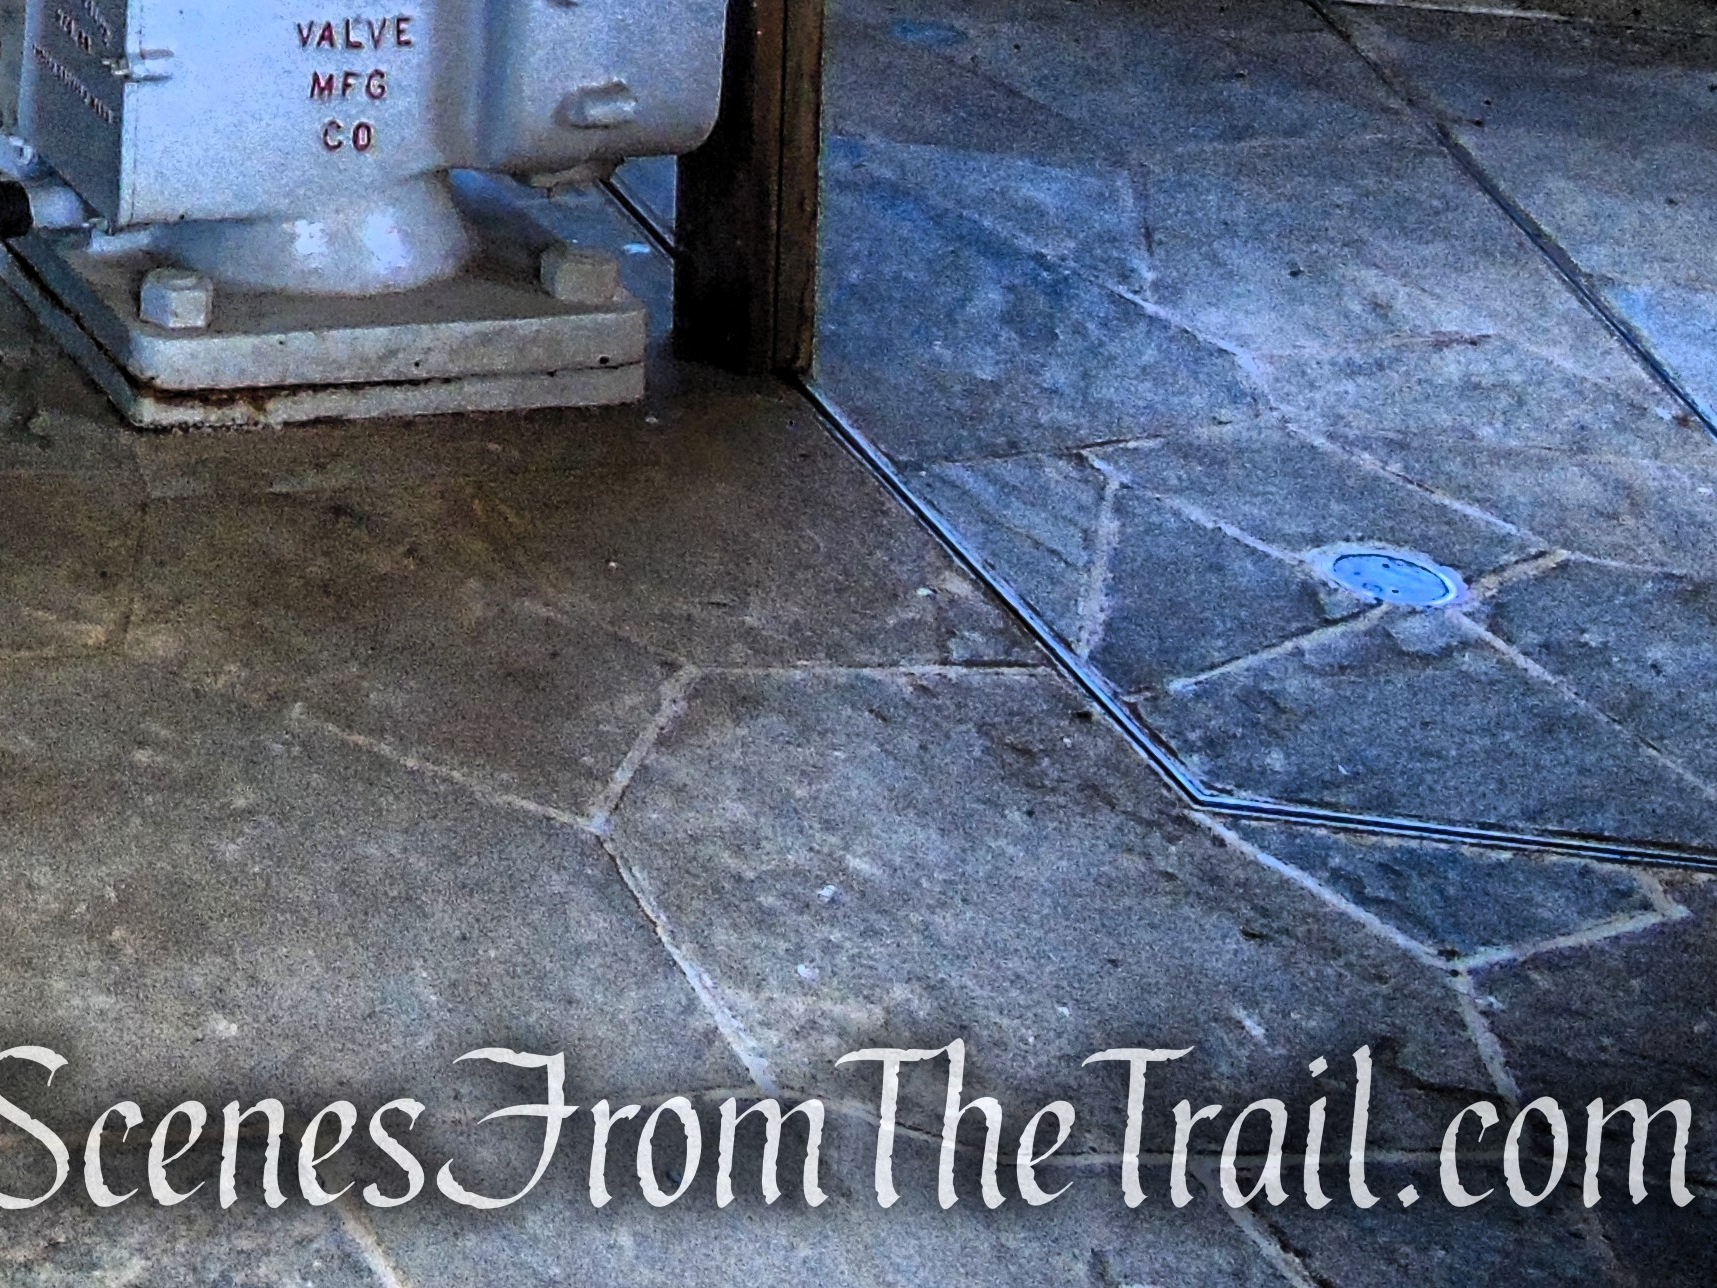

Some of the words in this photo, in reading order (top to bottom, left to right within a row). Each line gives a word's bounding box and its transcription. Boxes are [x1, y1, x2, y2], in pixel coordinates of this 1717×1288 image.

[296, 17, 413, 48] VALVE
[310, 69, 387, 100] MFG
[322, 119, 373, 151] CO
